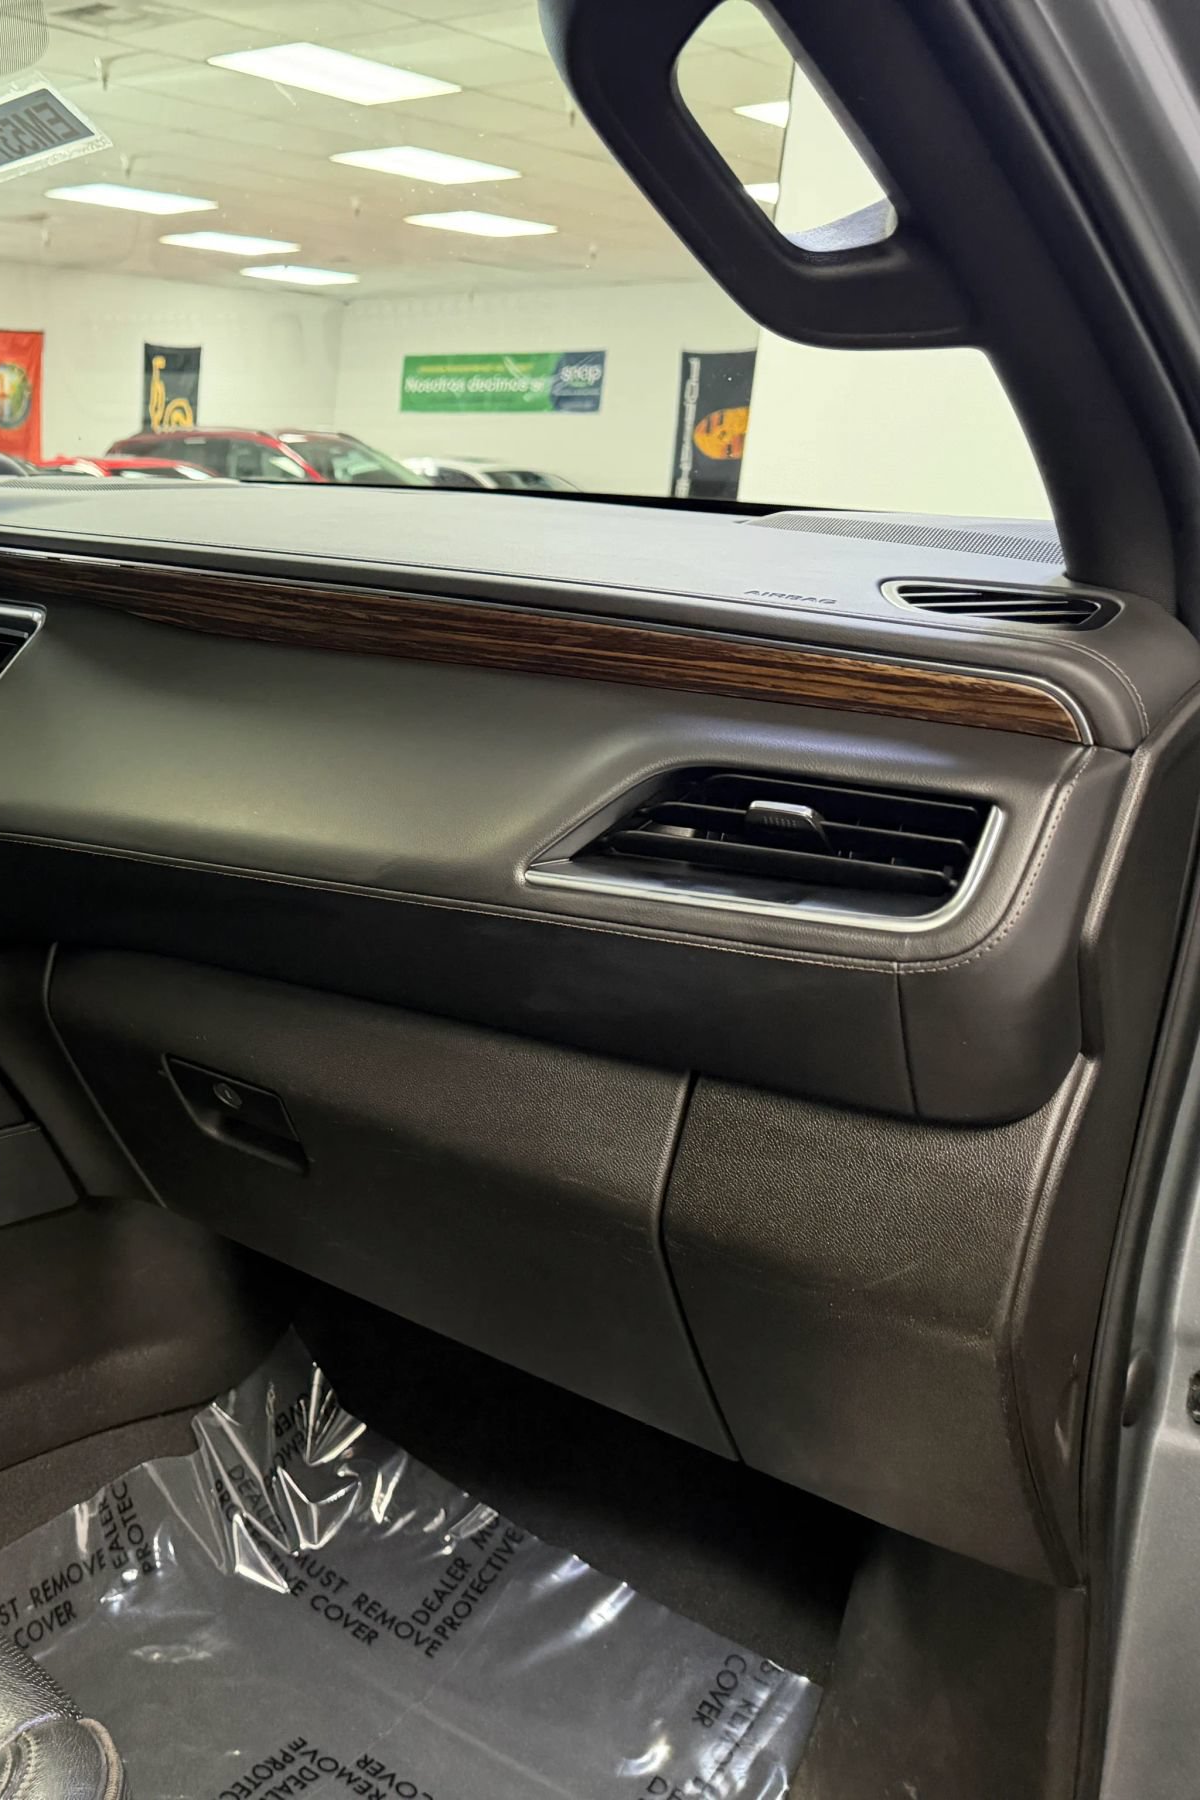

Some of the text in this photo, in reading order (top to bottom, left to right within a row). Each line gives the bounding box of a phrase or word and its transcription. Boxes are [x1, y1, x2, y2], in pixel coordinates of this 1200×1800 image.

[744, 590, 837, 604] AIRBAG
[29, 1548, 106, 1608] REMOVE
[287, 1554, 349, 1594] MUST
[352, 1592, 442, 1659] REMOVE
[411, 1557, 472, 1625] DEALER
[434, 1527, 525, 1640] PROTECTIVE
[13, 1600, 77, 1649] COVER
[310, 1595, 380, 1646] COVER
[692, 1654, 747, 1728] COVER
